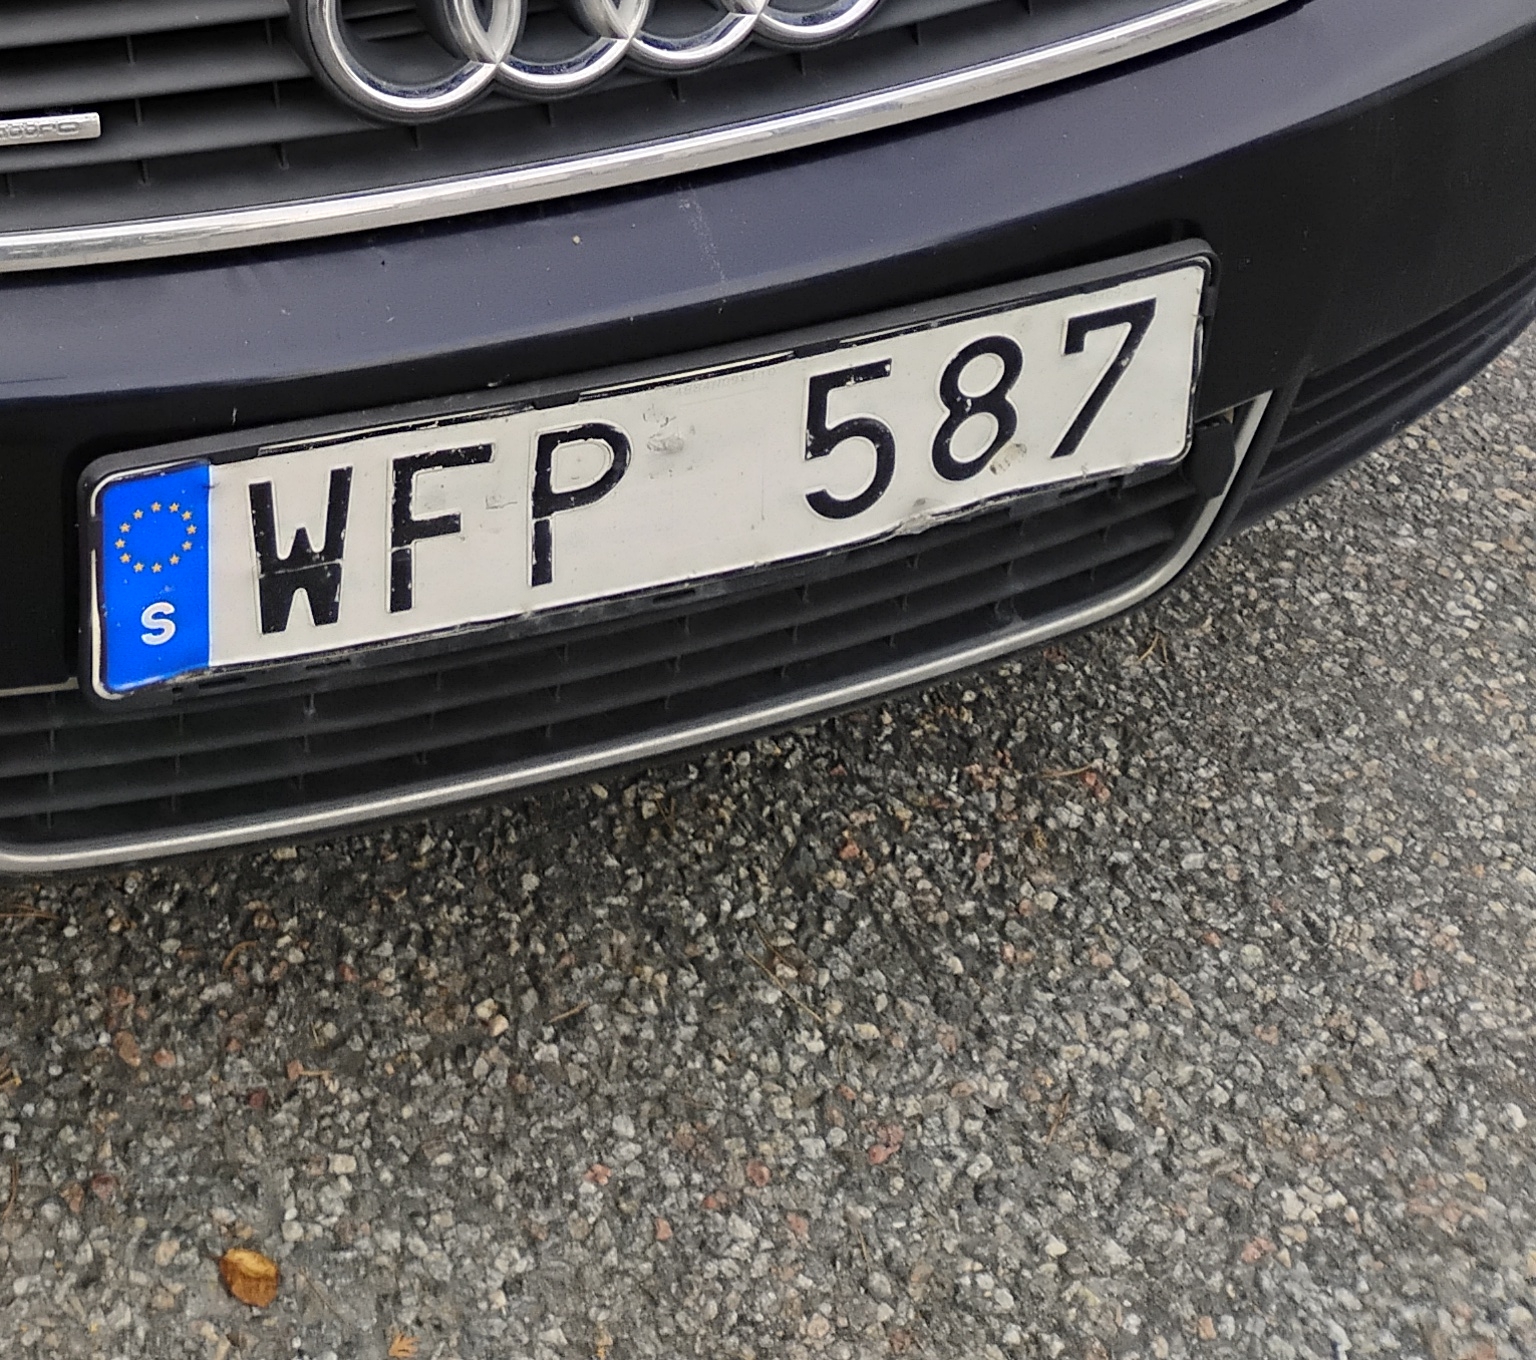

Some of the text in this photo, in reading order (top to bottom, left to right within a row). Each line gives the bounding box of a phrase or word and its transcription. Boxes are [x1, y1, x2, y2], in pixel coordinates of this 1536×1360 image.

[248, 297, 1157, 634] WFP 587
[140, 601, 177, 646] S
